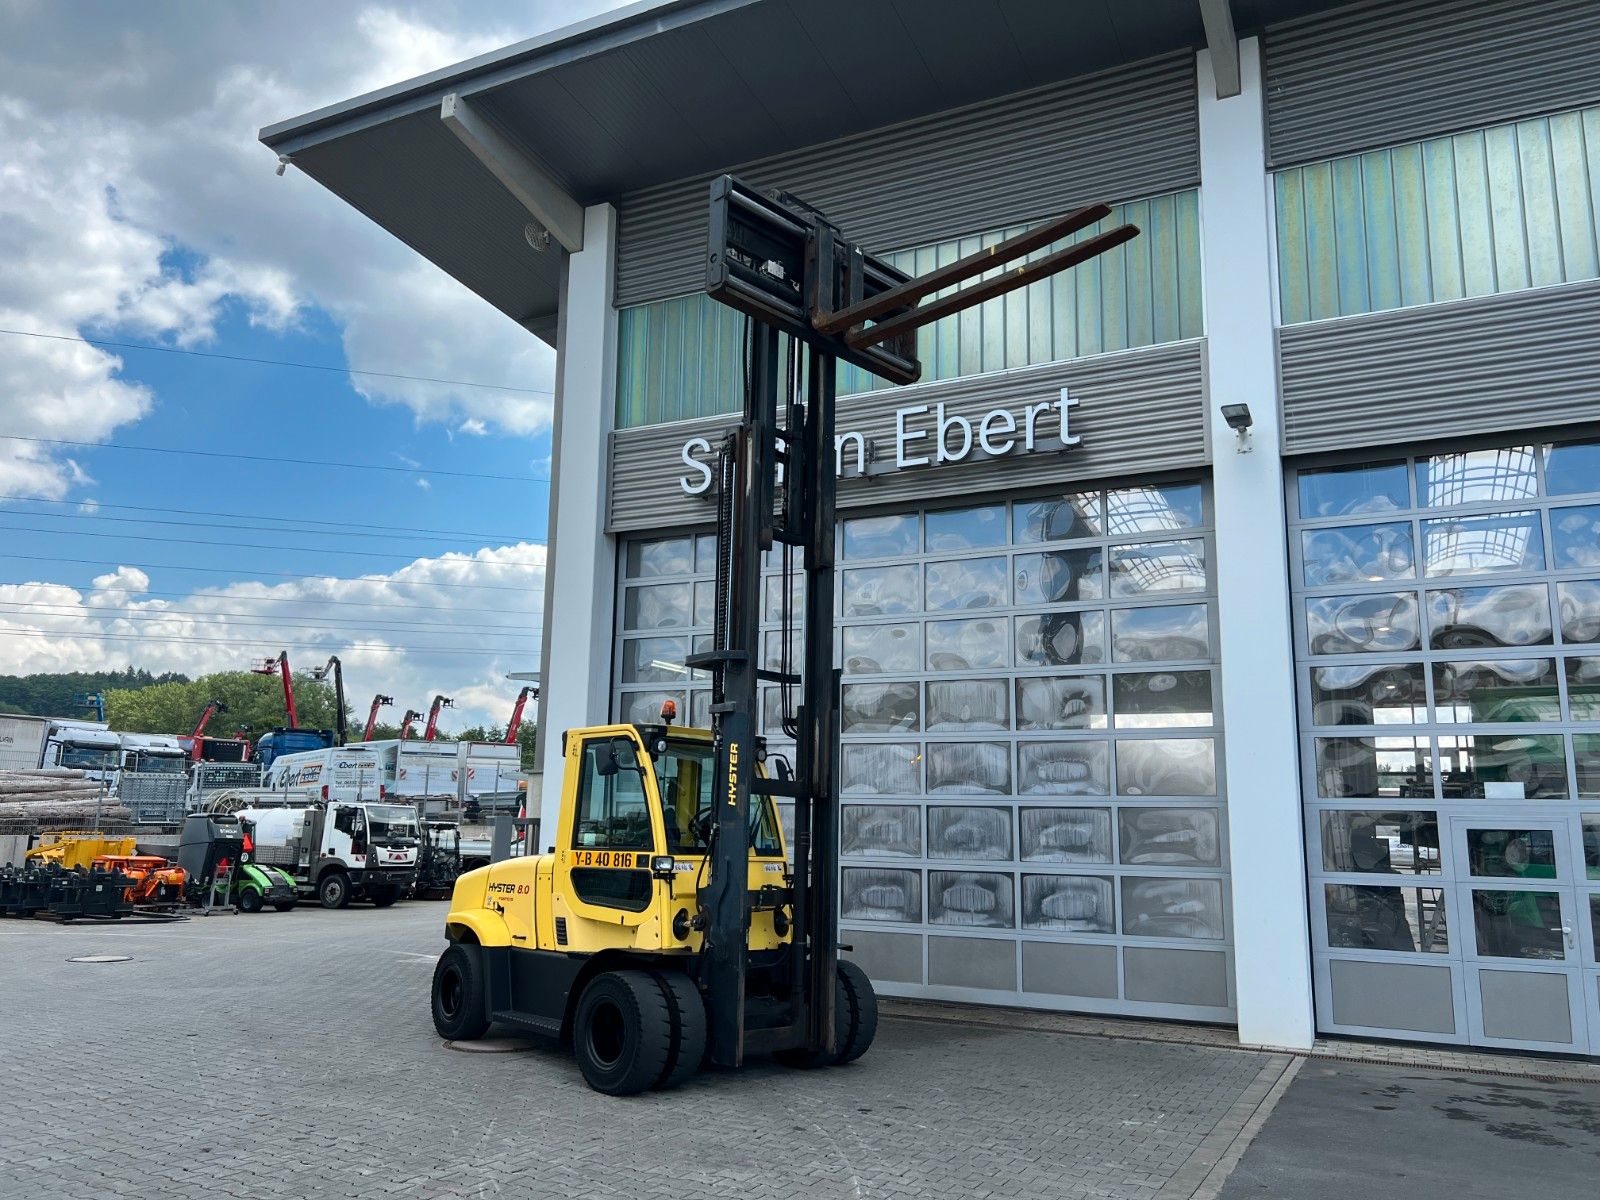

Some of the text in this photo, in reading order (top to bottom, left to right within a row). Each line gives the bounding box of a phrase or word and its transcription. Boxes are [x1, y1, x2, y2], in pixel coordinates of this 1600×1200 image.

[895, 387, 1081, 469] Ebert
[728, 743, 738, 806] HYSTER
[575, 851, 592, 866] Y-B
[595, 852, 610, 867] 40
[613, 853, 632, 868] 816
[488, 883, 530, 894] HYSTER 8.0
